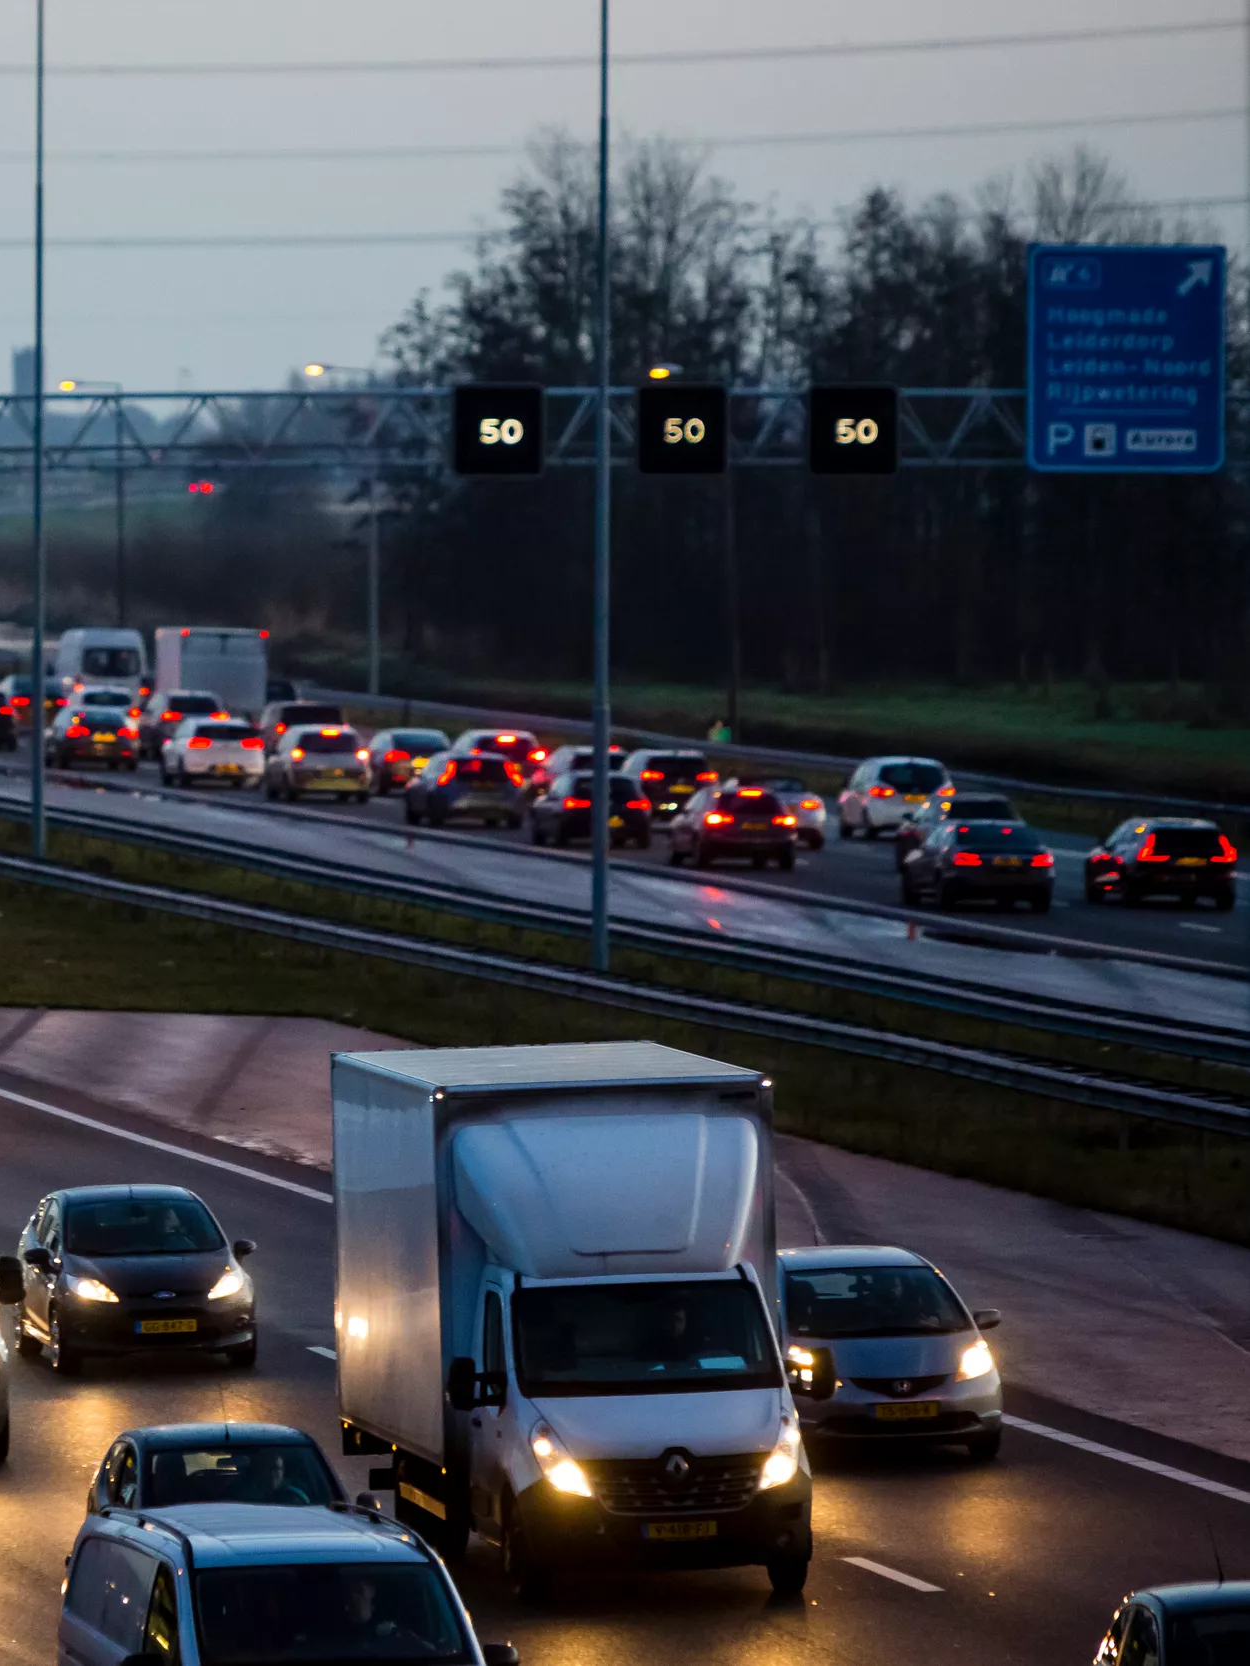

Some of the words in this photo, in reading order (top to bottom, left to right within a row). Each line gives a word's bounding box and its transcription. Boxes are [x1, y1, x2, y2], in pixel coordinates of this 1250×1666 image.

[1048, 305, 1168, 327] Hoogmade
[1048, 332, 1174, 353] Leiderdorp
[479, 417, 524, 445] 50
[663, 417, 706, 444] 50
[835, 417, 879, 445] 50
[1047, 422, 1075, 455] P
